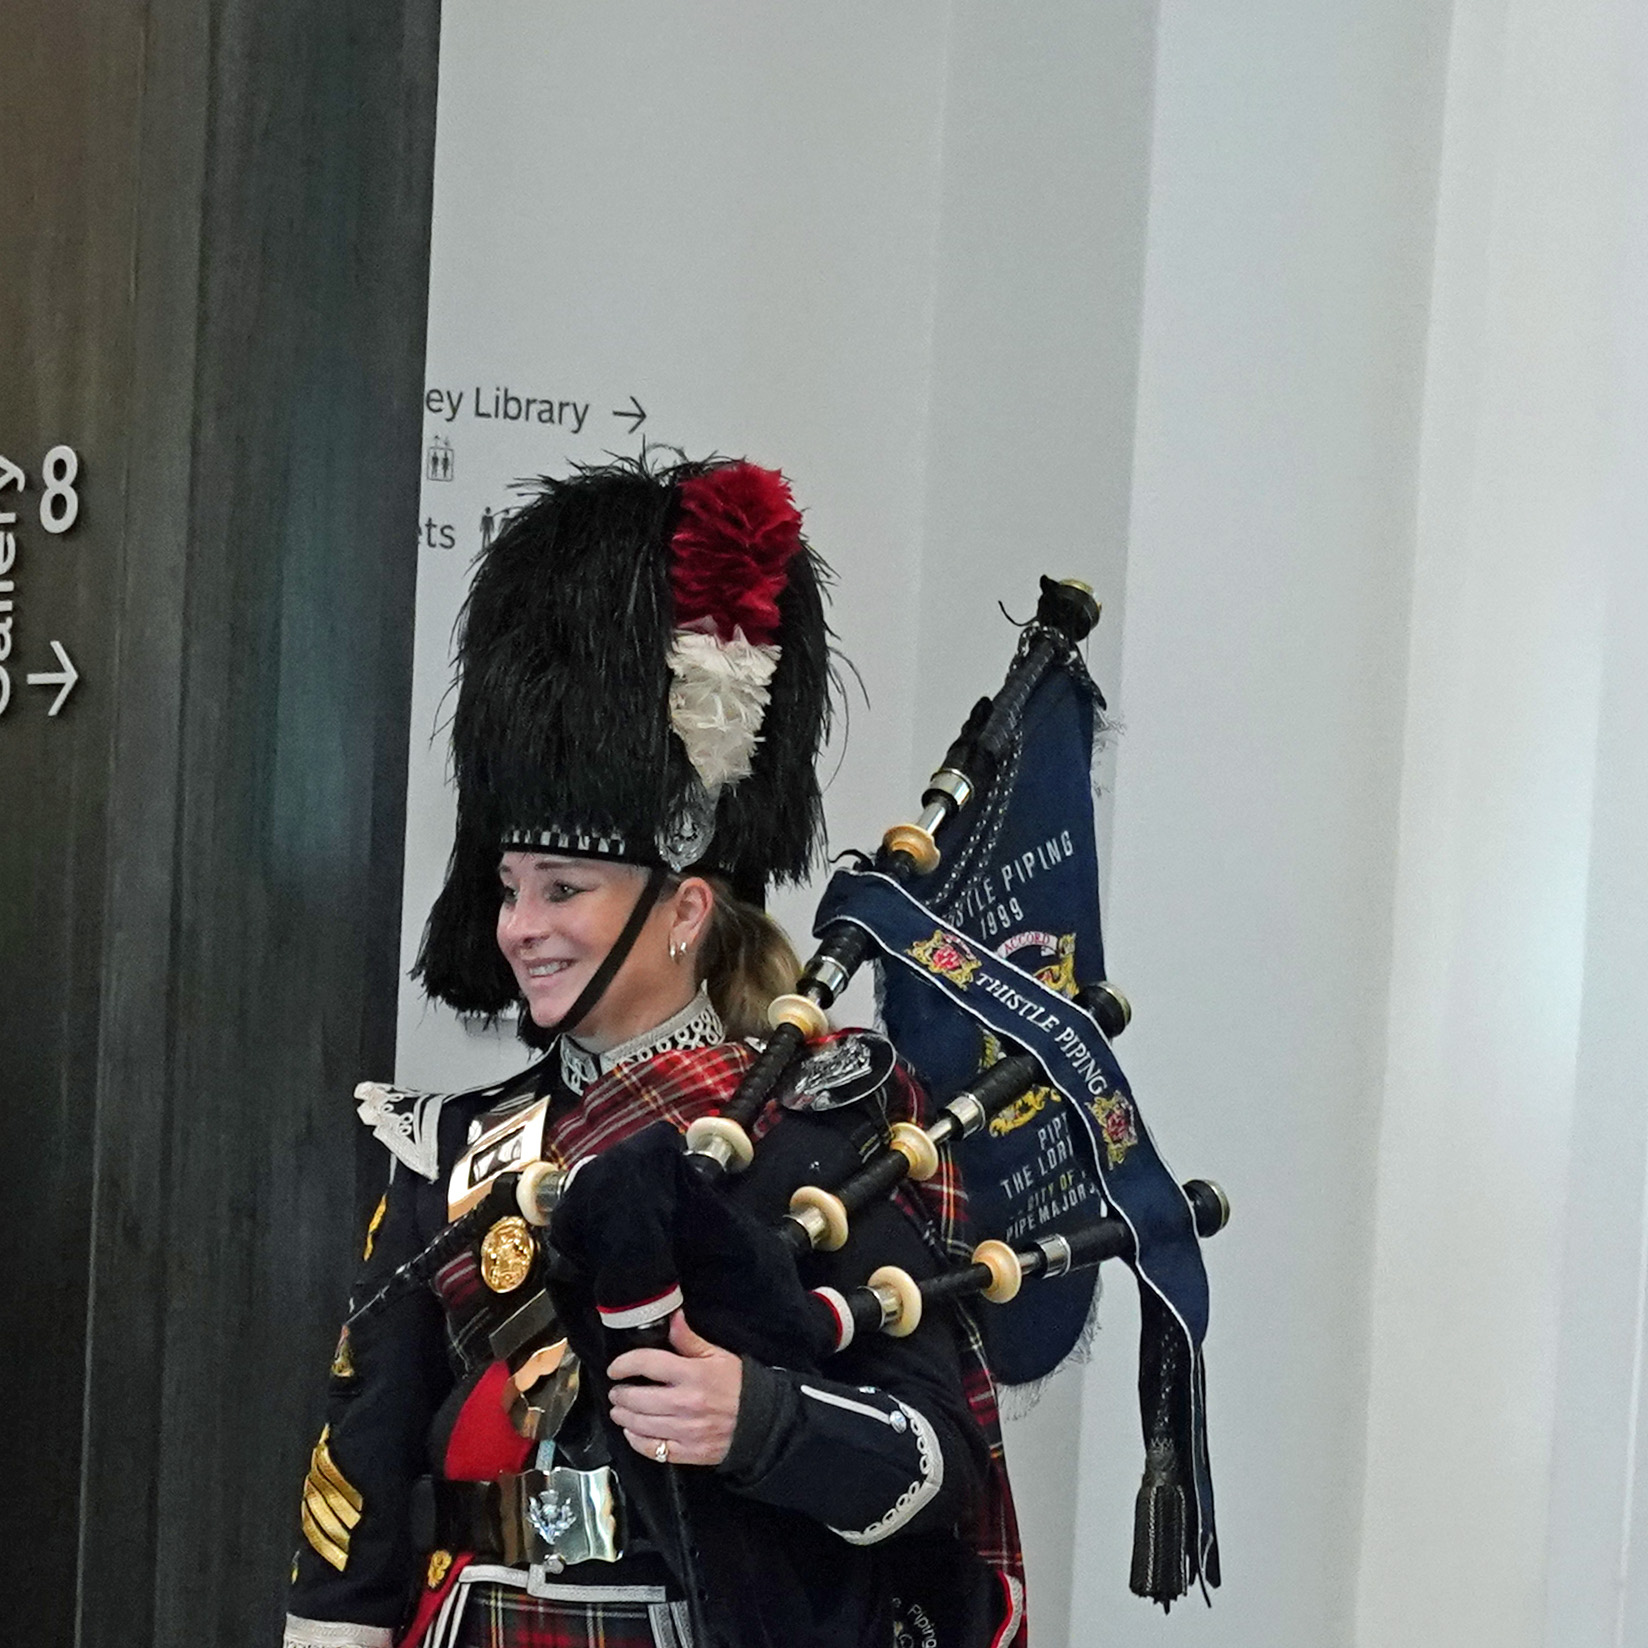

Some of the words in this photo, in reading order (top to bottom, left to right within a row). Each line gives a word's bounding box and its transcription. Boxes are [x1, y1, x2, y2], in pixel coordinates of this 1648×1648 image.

[425, 388, 464, 423] ey
[474, 386, 590, 434] Library
[39, 444, 79, 534] 8
[419, 517, 456, 550] ts
[1001, 830, 1074, 892] PIPING
[979, 896, 1025, 941] 1999
[1004, 931, 1051, 955] ACCORD
[976, 972, 1061, 1034] THISTLE
[1055, 1026, 1109, 1096] PIPING
[1000, 1164, 1034, 1200] THE
[1059, 1168, 1075, 1191] OF
[1006, 1213, 1037, 1243] PIPE
[1038, 1183, 1087, 1225] MAJOR
